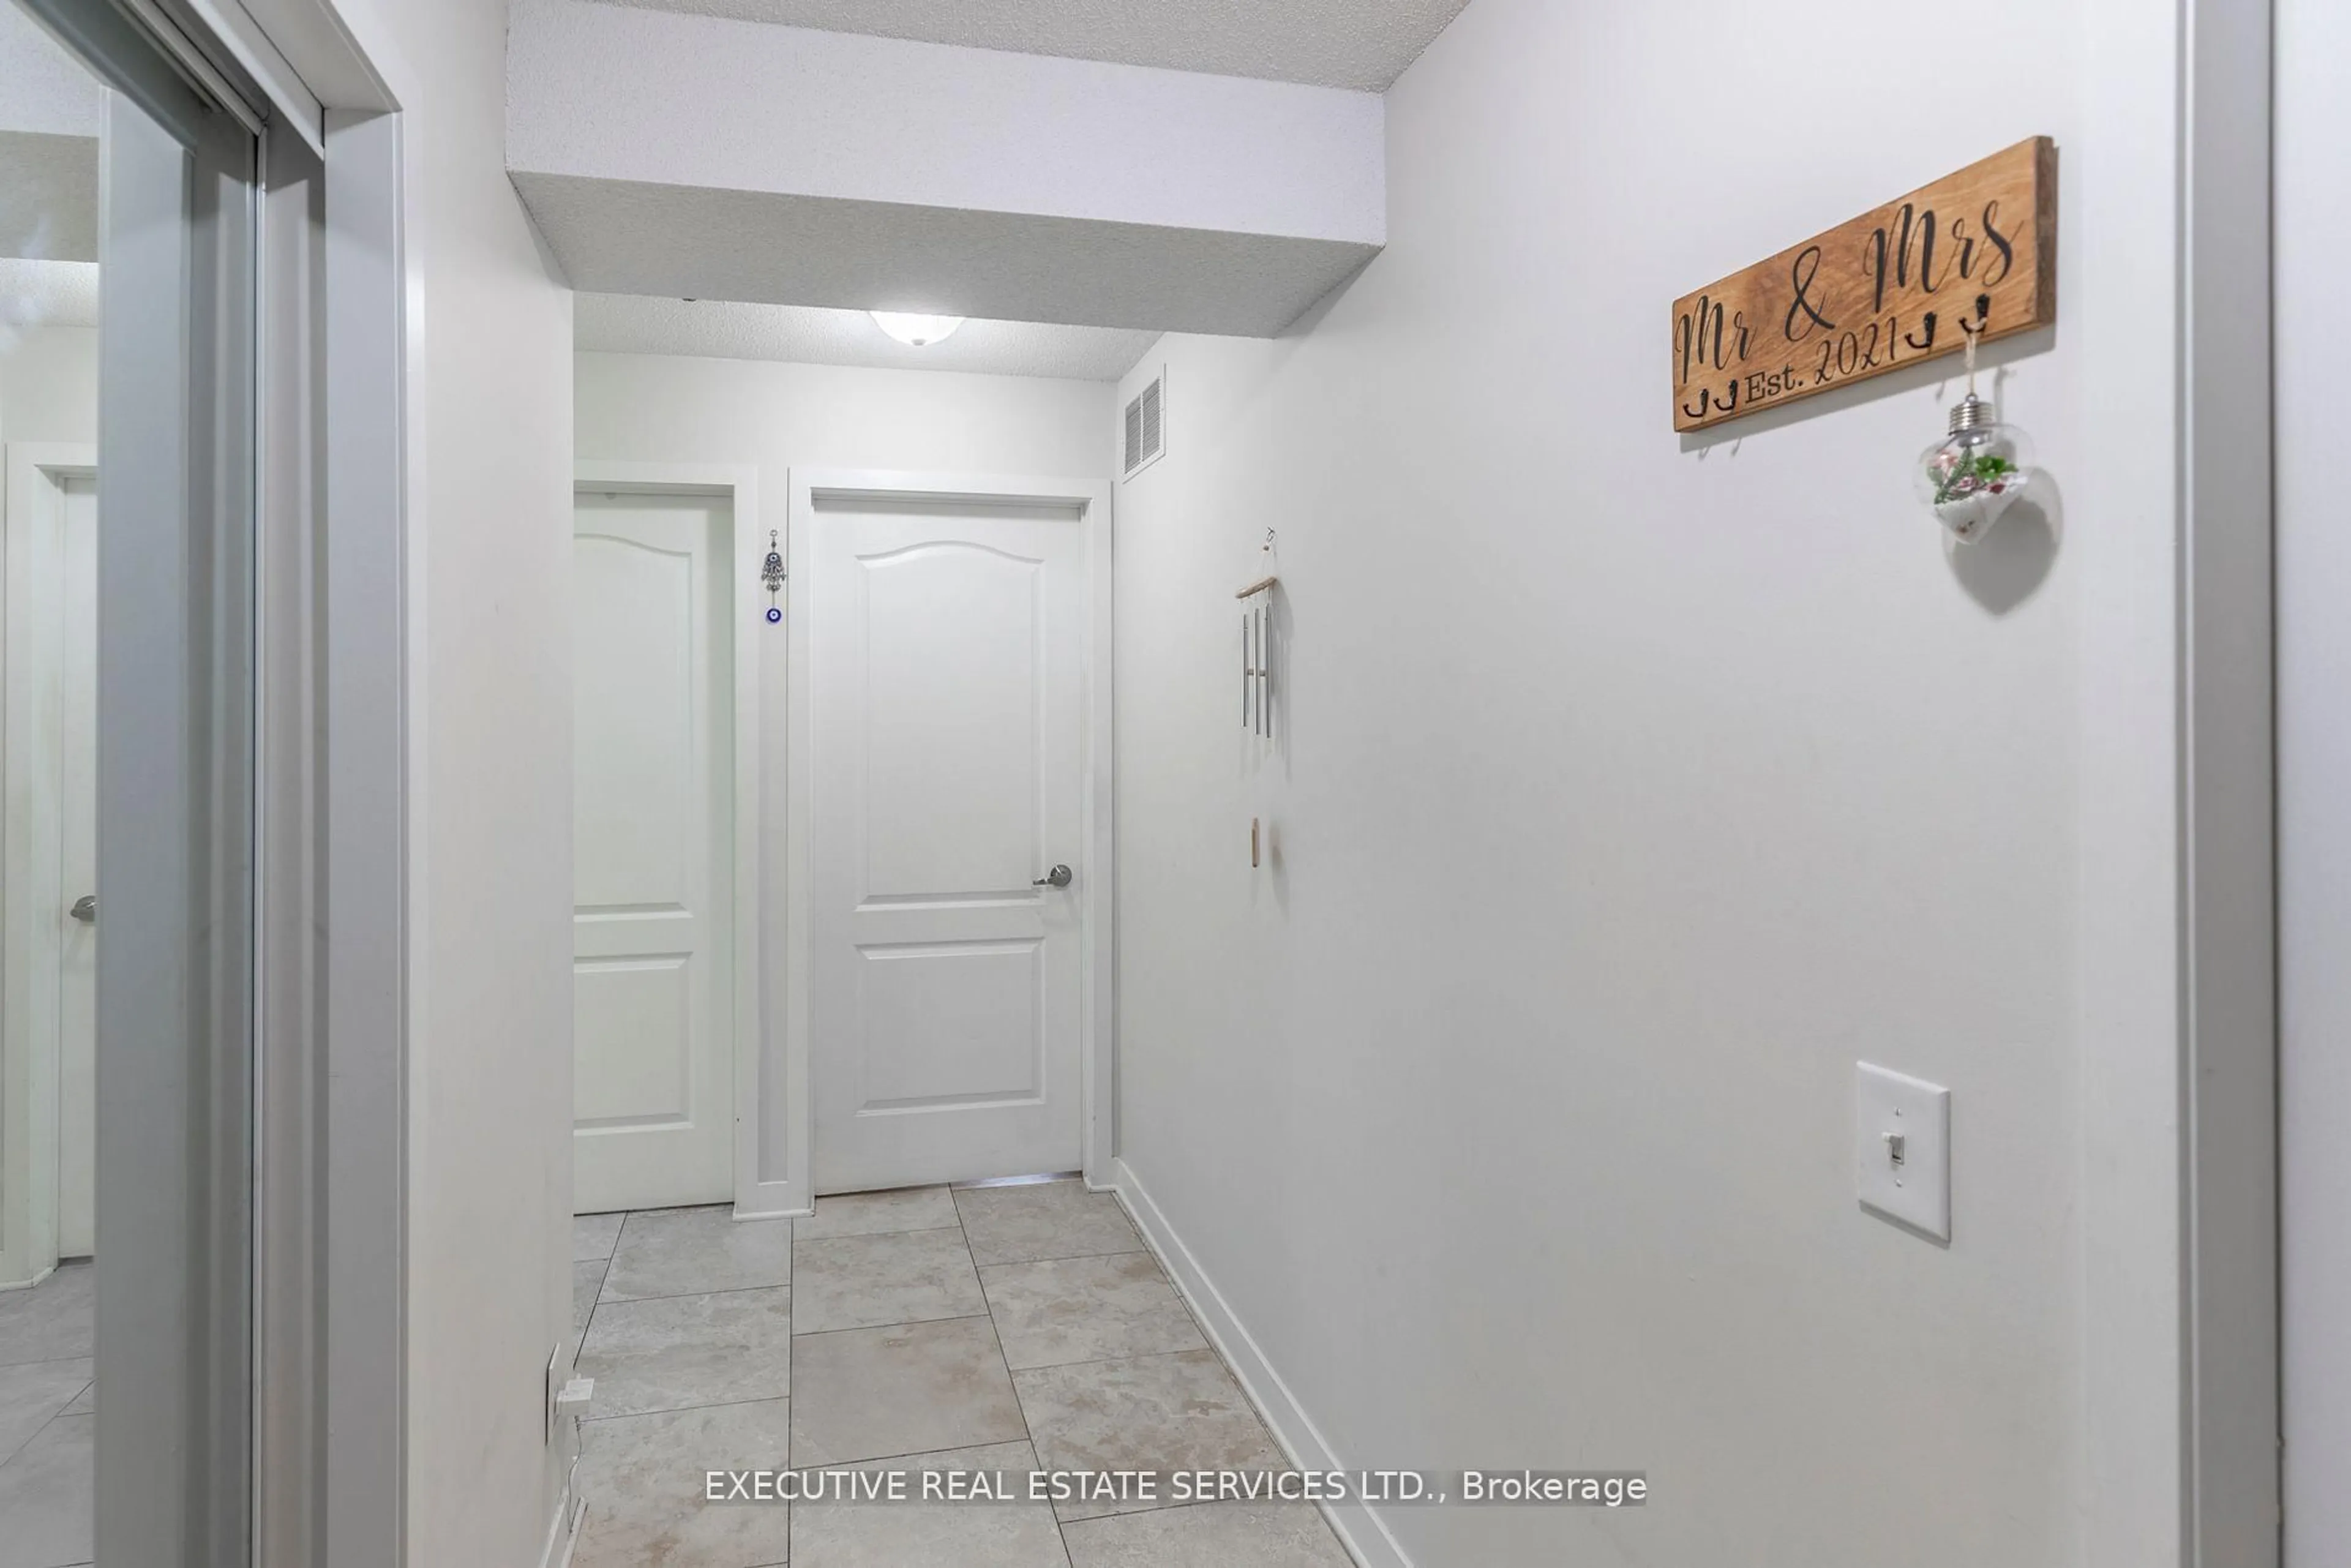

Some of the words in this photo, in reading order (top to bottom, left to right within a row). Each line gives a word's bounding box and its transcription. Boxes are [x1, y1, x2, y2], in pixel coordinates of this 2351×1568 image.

[1676, 294, 1757, 384] Mr
[1785, 245, 1835, 343] &
[1863, 200, 2024, 314] Mrs
[1744, 364, 1803, 404] Est.
[1814, 316, 1897, 386] 2021
